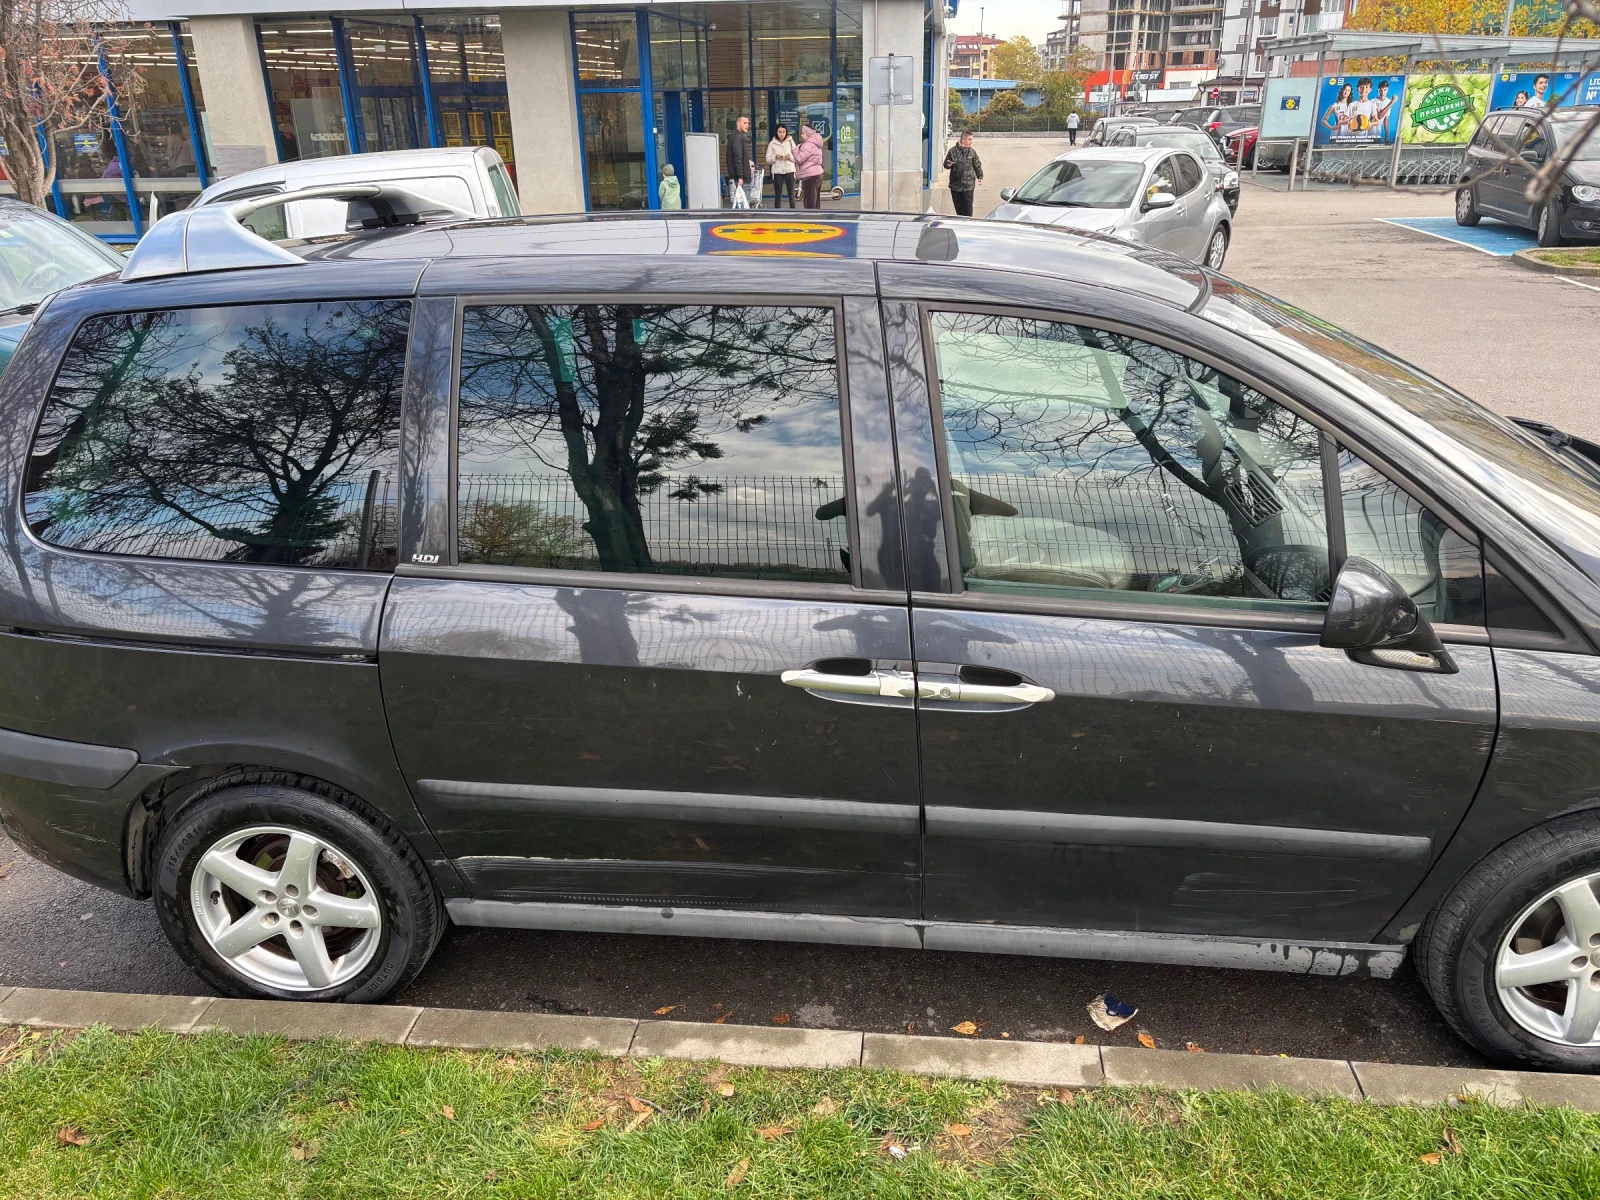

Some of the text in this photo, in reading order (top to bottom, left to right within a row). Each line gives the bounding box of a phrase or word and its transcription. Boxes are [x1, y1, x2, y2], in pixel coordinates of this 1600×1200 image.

[1425, 87, 1451, 103] СВЕЖИ
[1419, 100, 1466, 118] ПРОВЕРЕНИ
[411, 553, 440, 564] HDI
[366, 962, 394, 994] OUTSIDE
